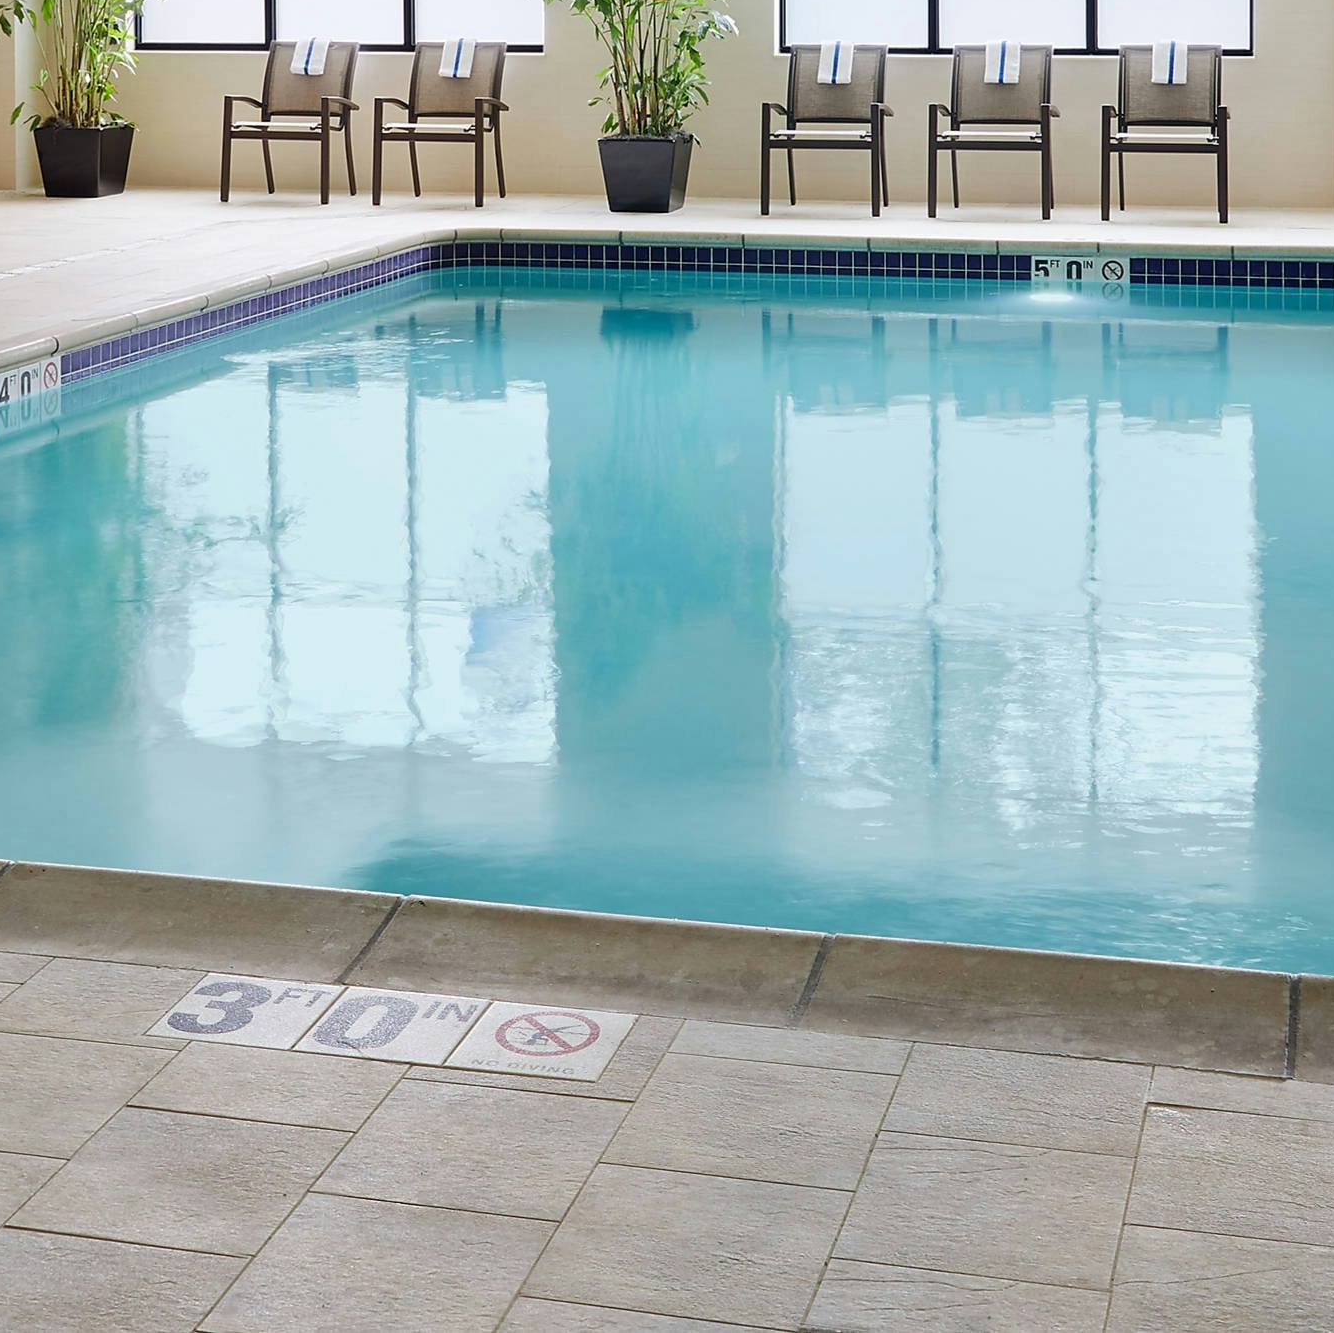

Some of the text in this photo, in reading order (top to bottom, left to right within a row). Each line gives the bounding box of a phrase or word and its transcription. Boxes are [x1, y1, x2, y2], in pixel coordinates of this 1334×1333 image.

[1034, 260, 1049, 277] 5
[1050, 260, 1060, 268] FT
[1083, 261, 1093, 269] IN
[166, 979, 478, 1051] 3 FT 0 IN
[470, 1058, 576, 1075] NO DIVING
